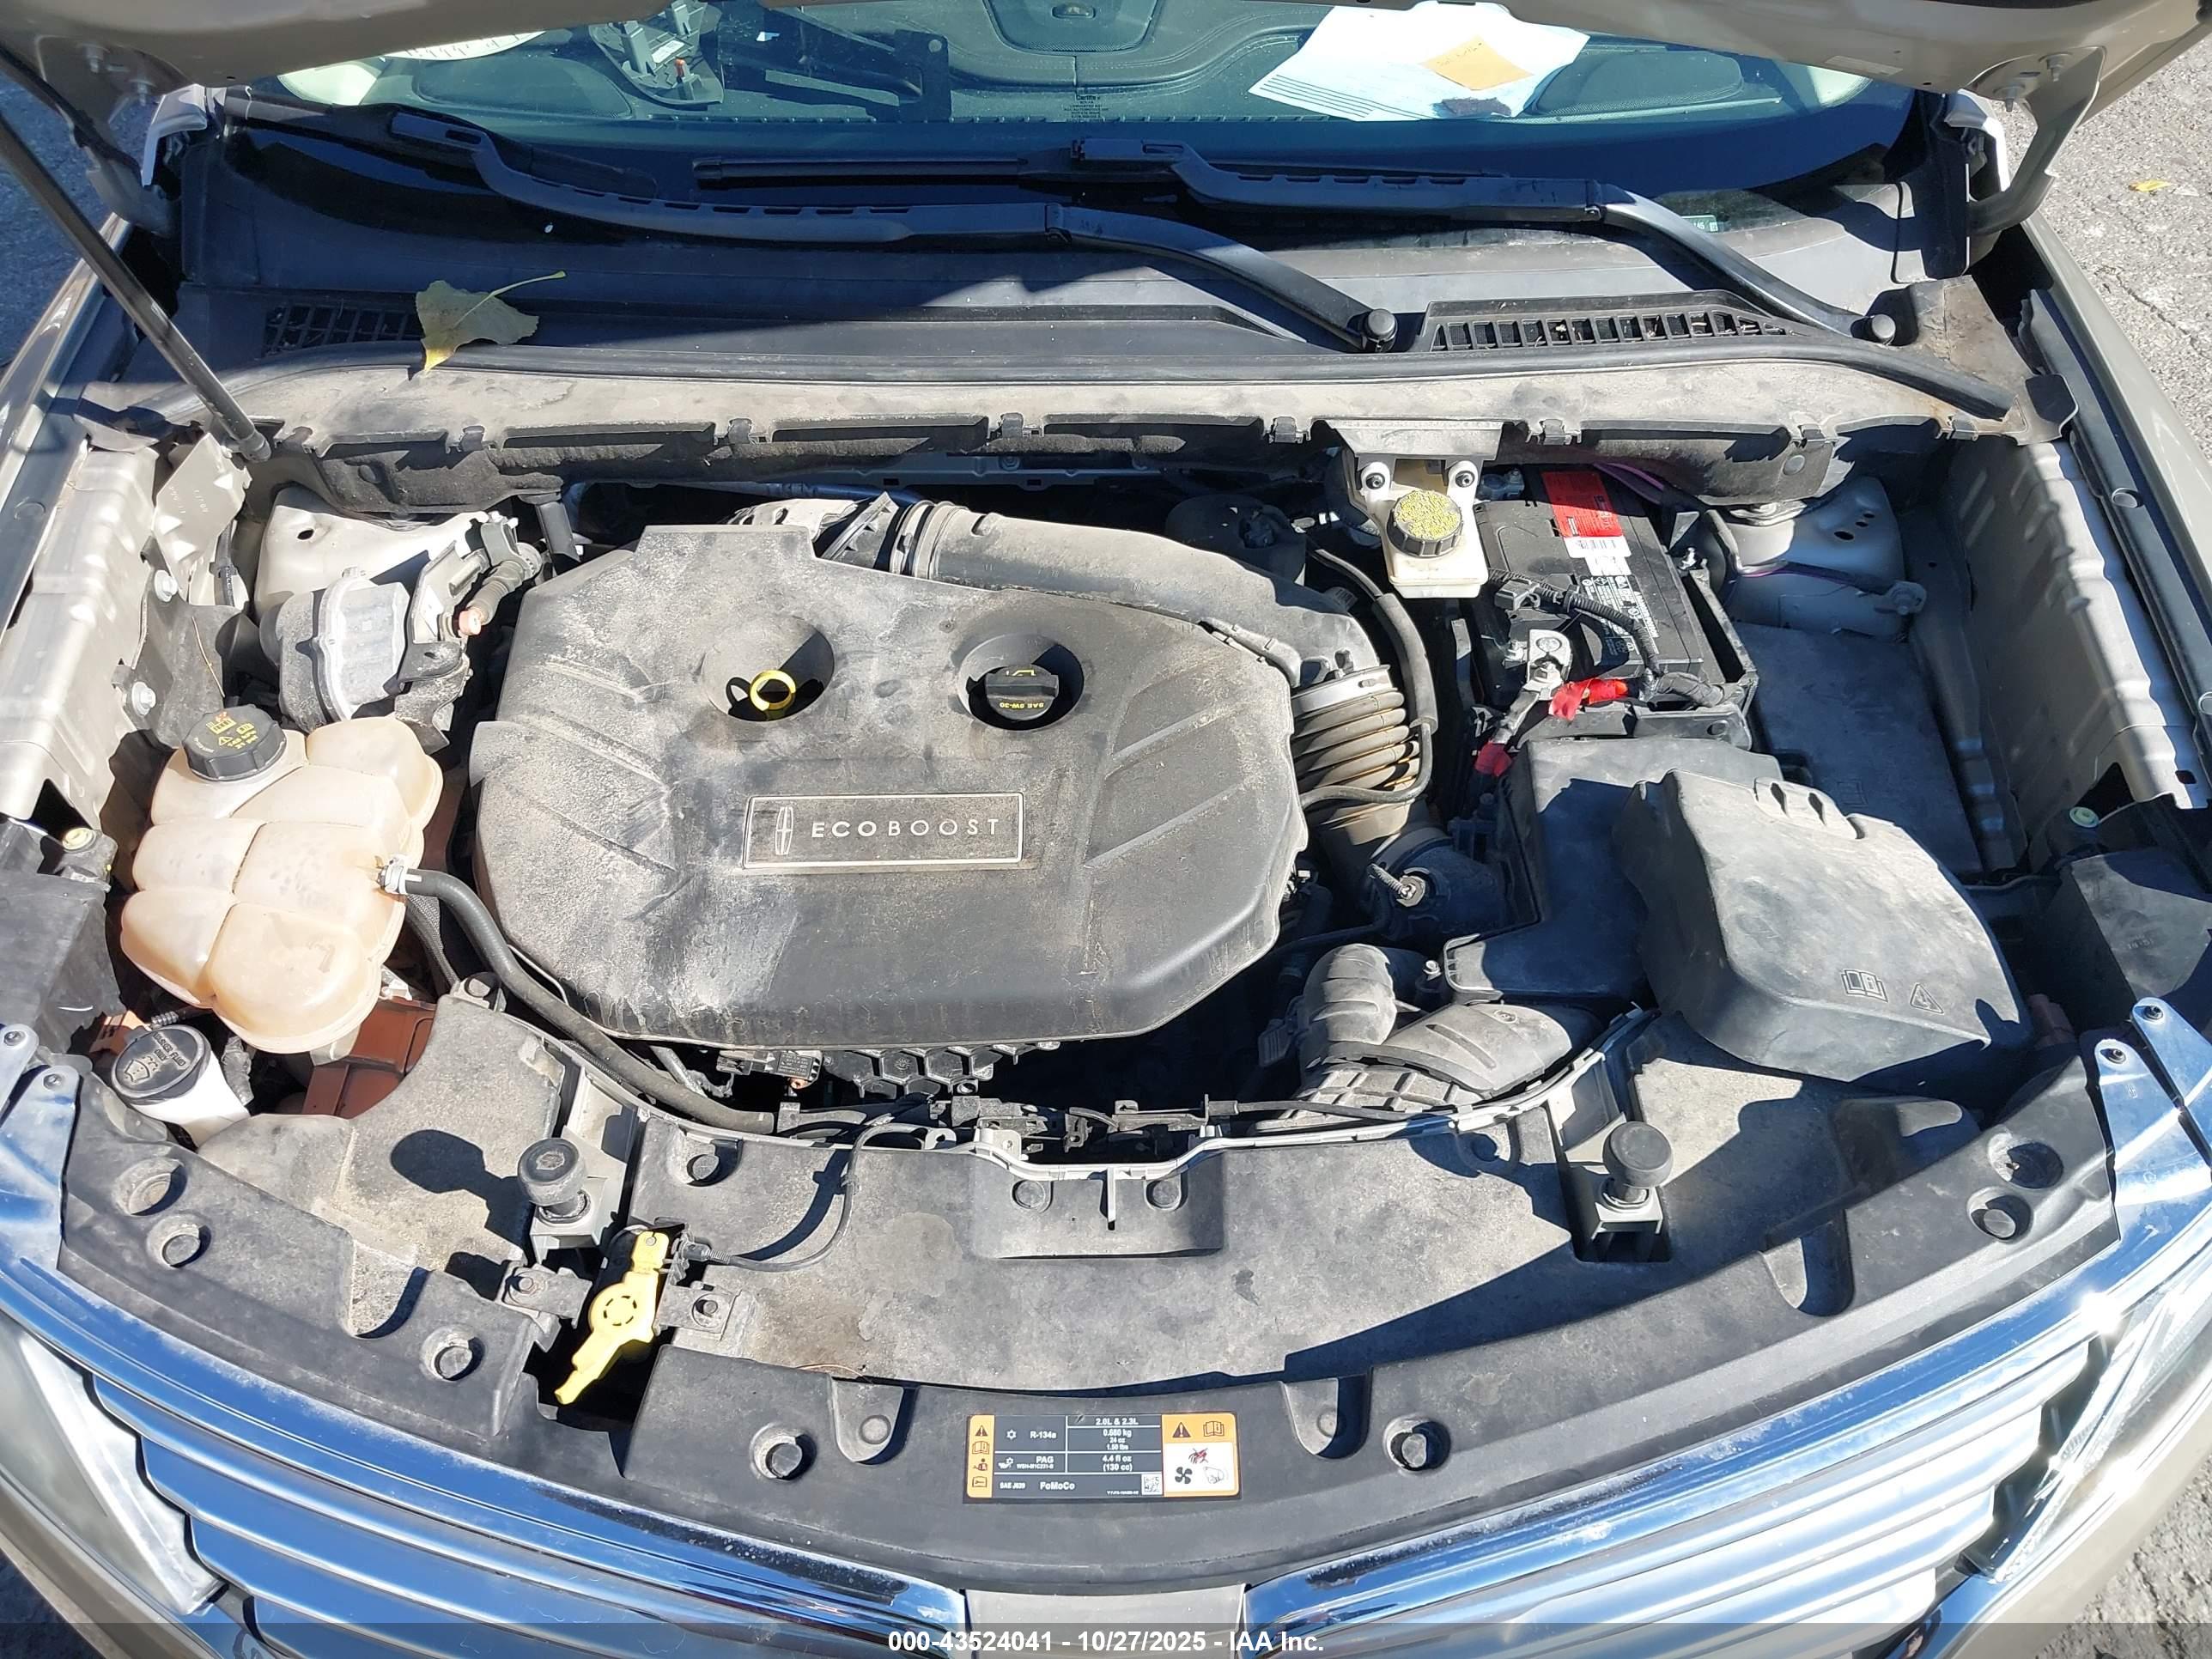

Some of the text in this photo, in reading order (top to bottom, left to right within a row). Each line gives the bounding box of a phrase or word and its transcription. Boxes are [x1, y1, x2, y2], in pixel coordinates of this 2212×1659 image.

[811, 818, 999, 838] ECOBOOST
[1121, 1417, 1139, 1425] 2.3L
[1030, 1431, 1057, 1439] R-134a
[1122, 1428, 1132, 1437] kg
[1036, 1455, 1054, 1464] PAG
[1102, 1454, 1115, 1462] 4.4
[1115, 1454, 1121, 1462] fl
[1103, 1462, 1133, 1472] (130 cc)
[1040, 1481, 1076, 1491] FoMoCo
